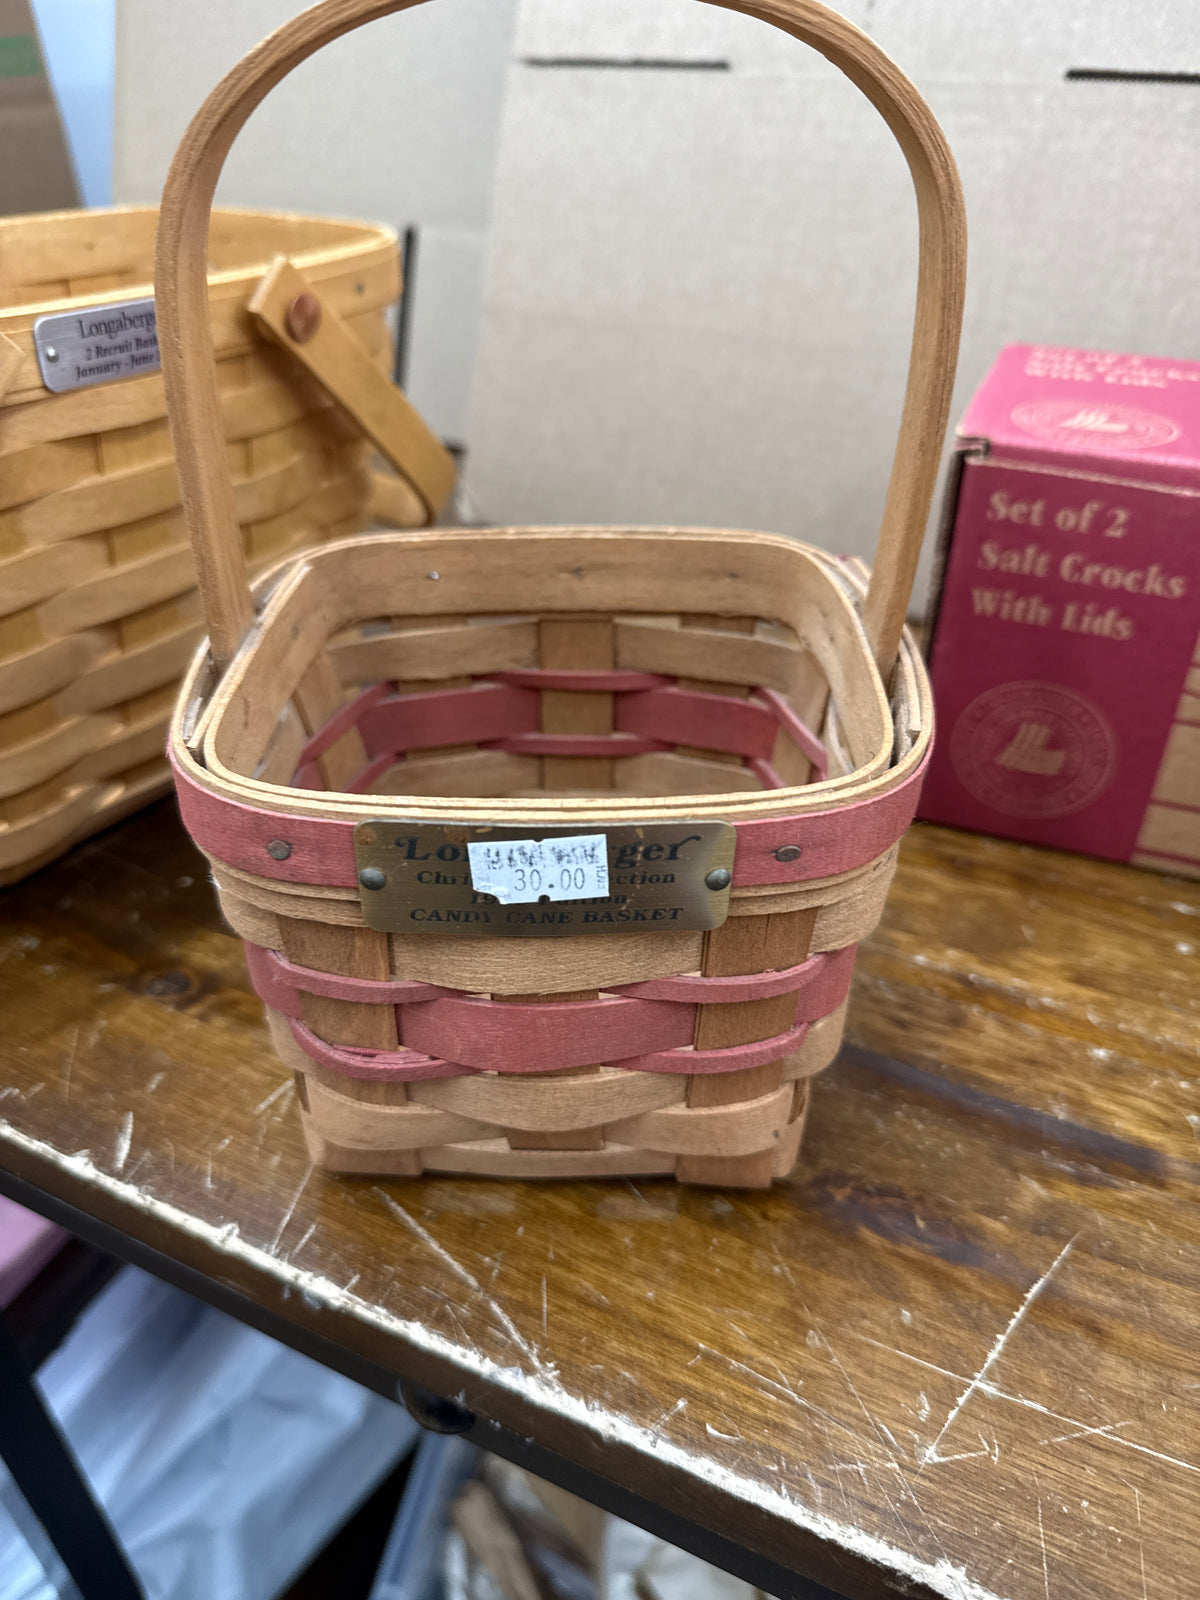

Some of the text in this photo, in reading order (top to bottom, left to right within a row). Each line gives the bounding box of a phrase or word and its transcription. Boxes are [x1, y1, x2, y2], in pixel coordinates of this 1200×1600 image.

[79, 311, 156, 340] Longaberg
[95, 341, 132, 359] Recruit
[76, 361, 121, 381] January
[130, 353, 154, 370] June
[987, 490, 1130, 538] Set of 2
[977, 541, 1186, 599] Salt Crocks
[971, 587, 1135, 641] With Lids
[514, 867, 586, 891] 30.00
[409, 907, 685, 925] CANDY CANE BASKET
